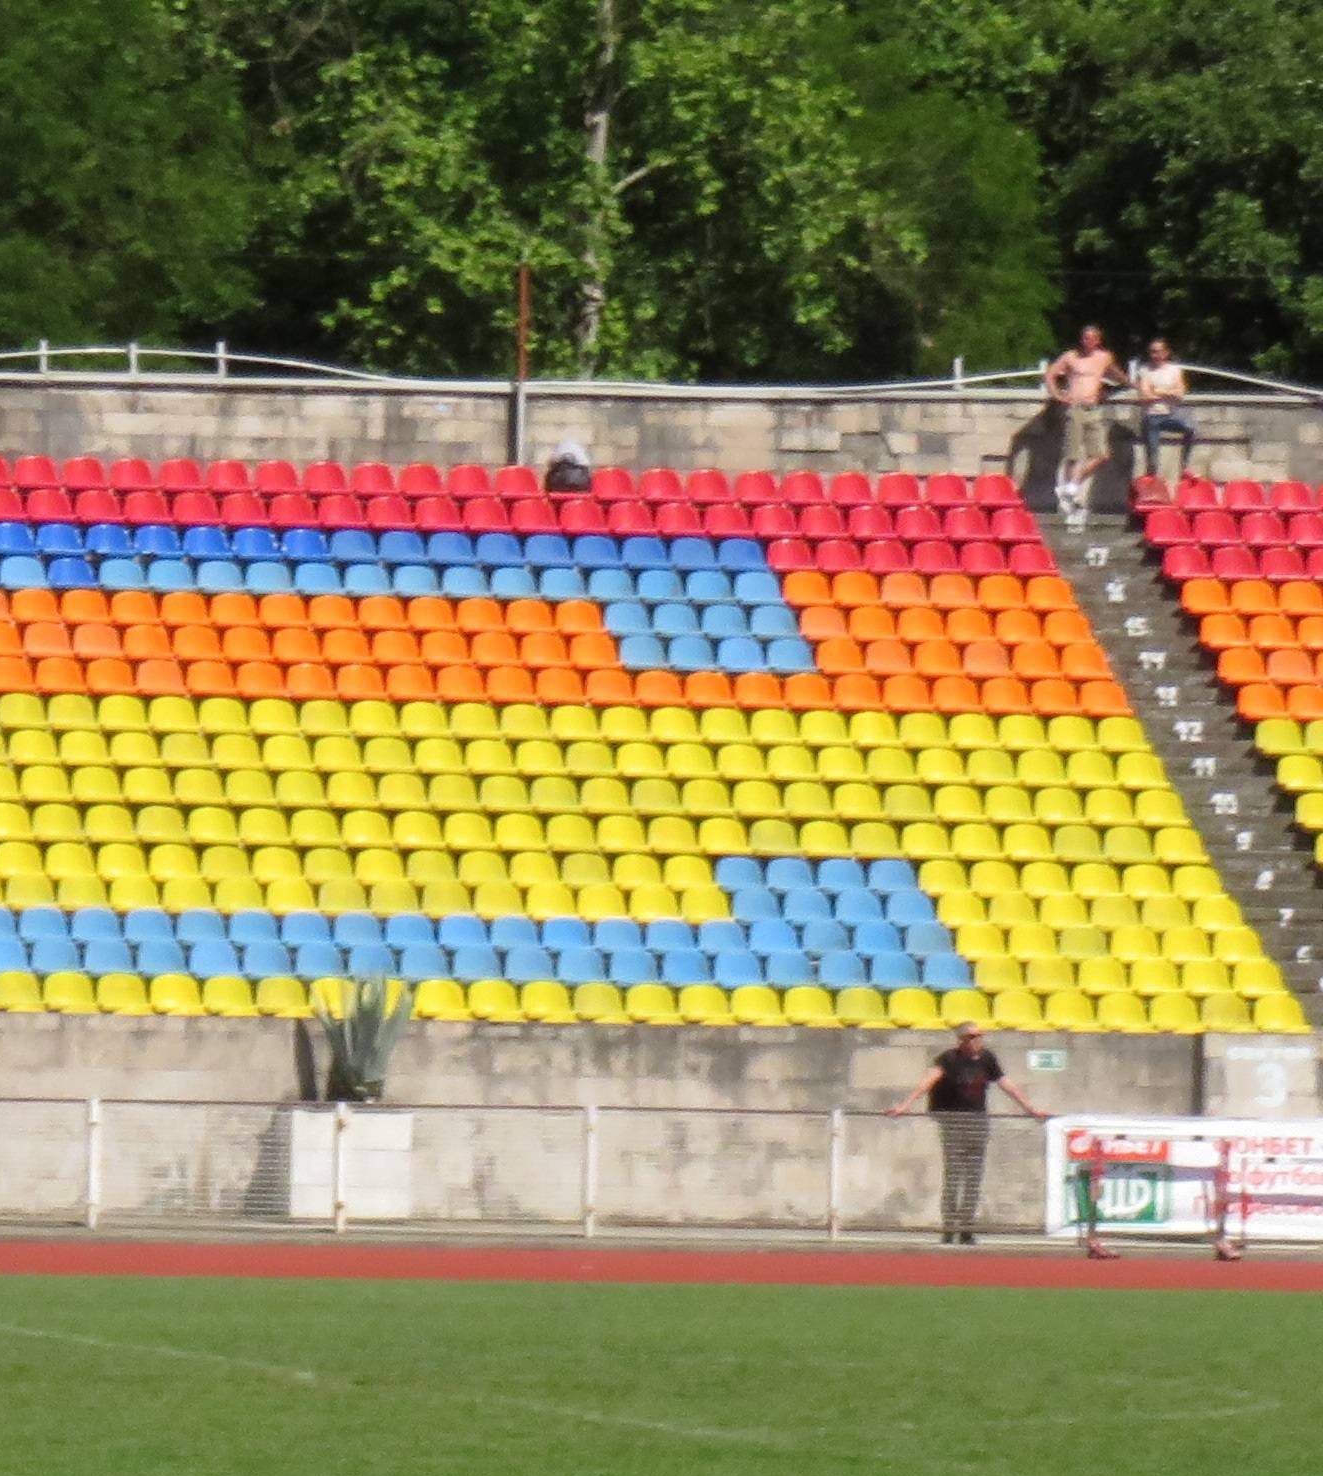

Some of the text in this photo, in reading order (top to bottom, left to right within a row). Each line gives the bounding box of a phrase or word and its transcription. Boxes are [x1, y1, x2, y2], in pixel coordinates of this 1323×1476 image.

[1173, 721, 1204, 742] 12
[1277, 908, 1295, 928] 7
[1256, 1062, 1287, 1107] 3
